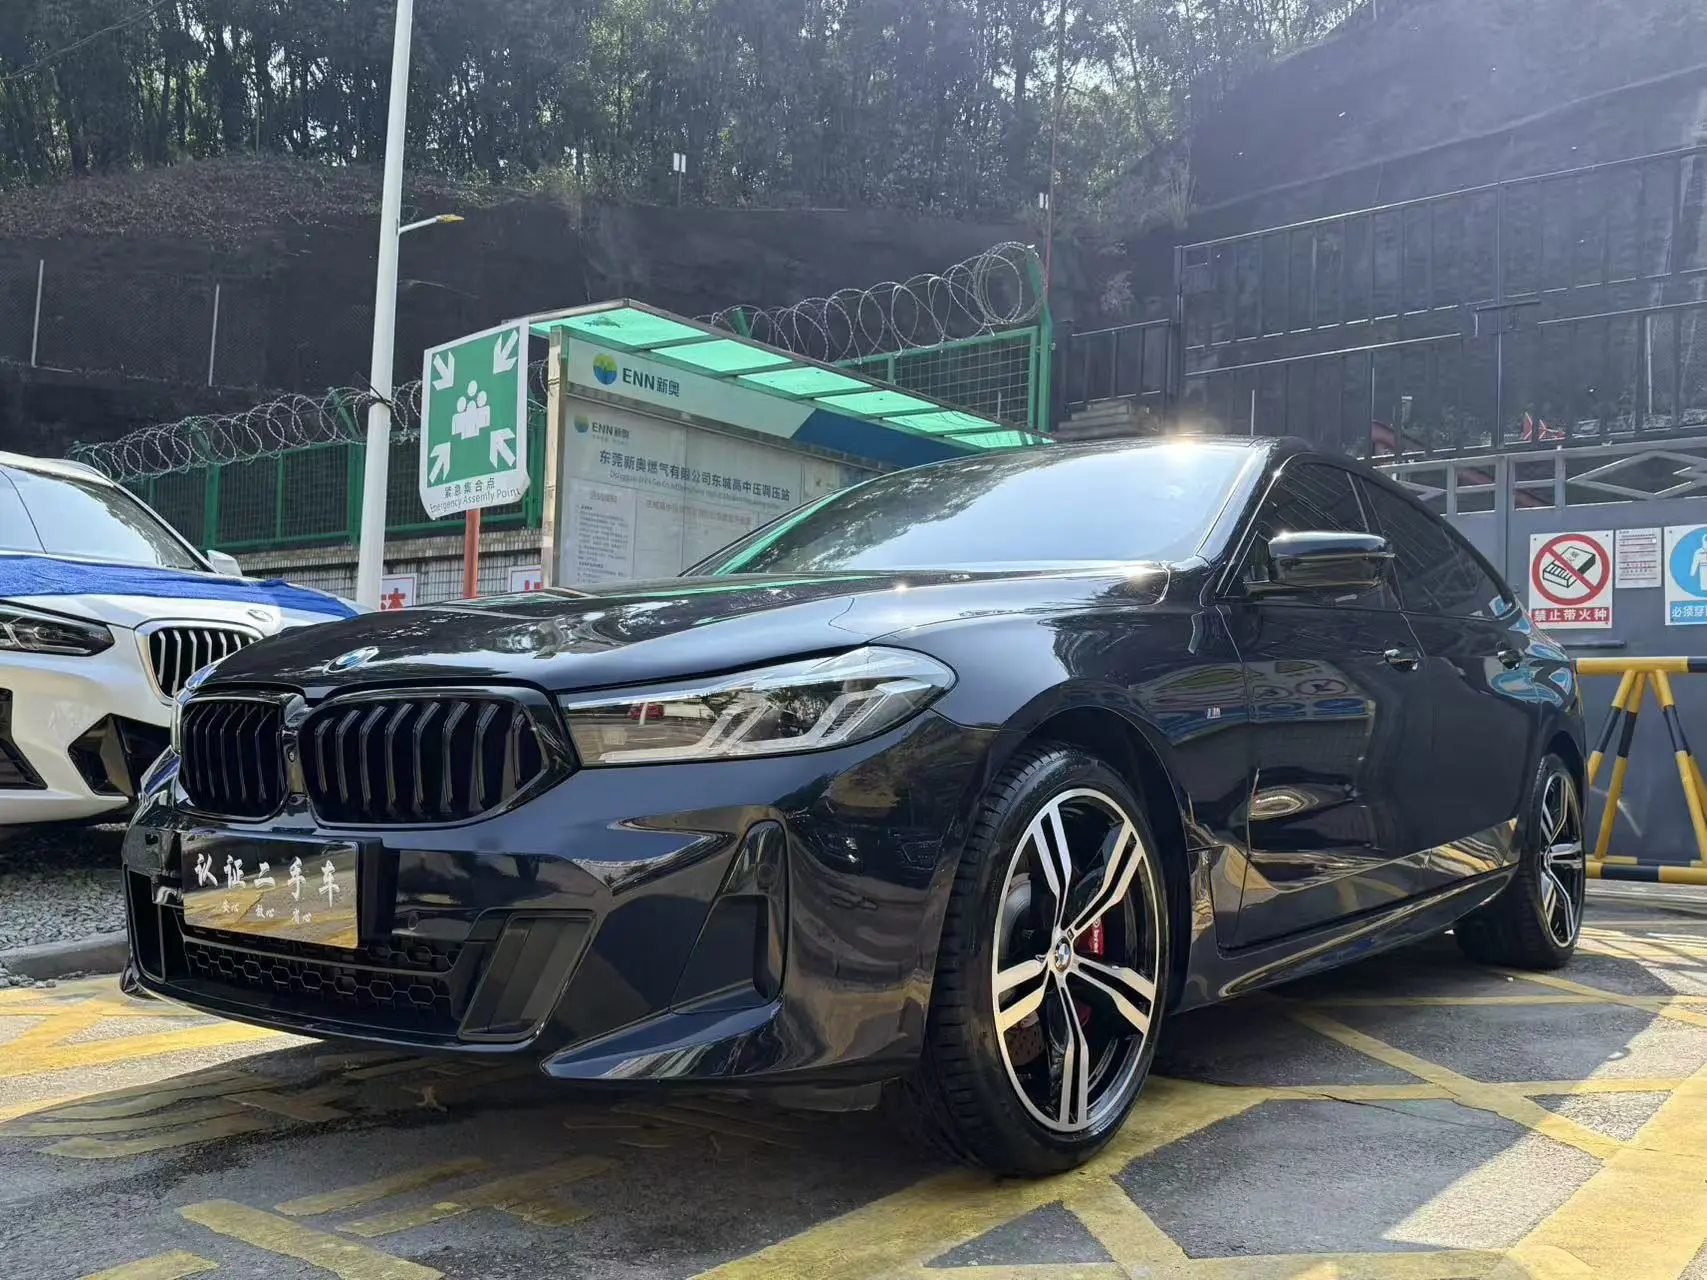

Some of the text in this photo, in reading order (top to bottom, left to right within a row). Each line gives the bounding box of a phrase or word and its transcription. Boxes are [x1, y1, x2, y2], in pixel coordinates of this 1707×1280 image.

[622, 367, 680, 398] ENN新奥
[444, 477, 495, 498] 紧急集合点
[599, 450, 790, 502] 东莞新奥燃气有限公司东城高中压调压站
[429, 497, 461, 513] Emergency
[496, 487, 521, 499] Point
[1534, 609, 1607, 622] 禁止带火种
[1672, 605, 1707, 618] 必须穿
[194, 853, 341, 908] 认证二手车
